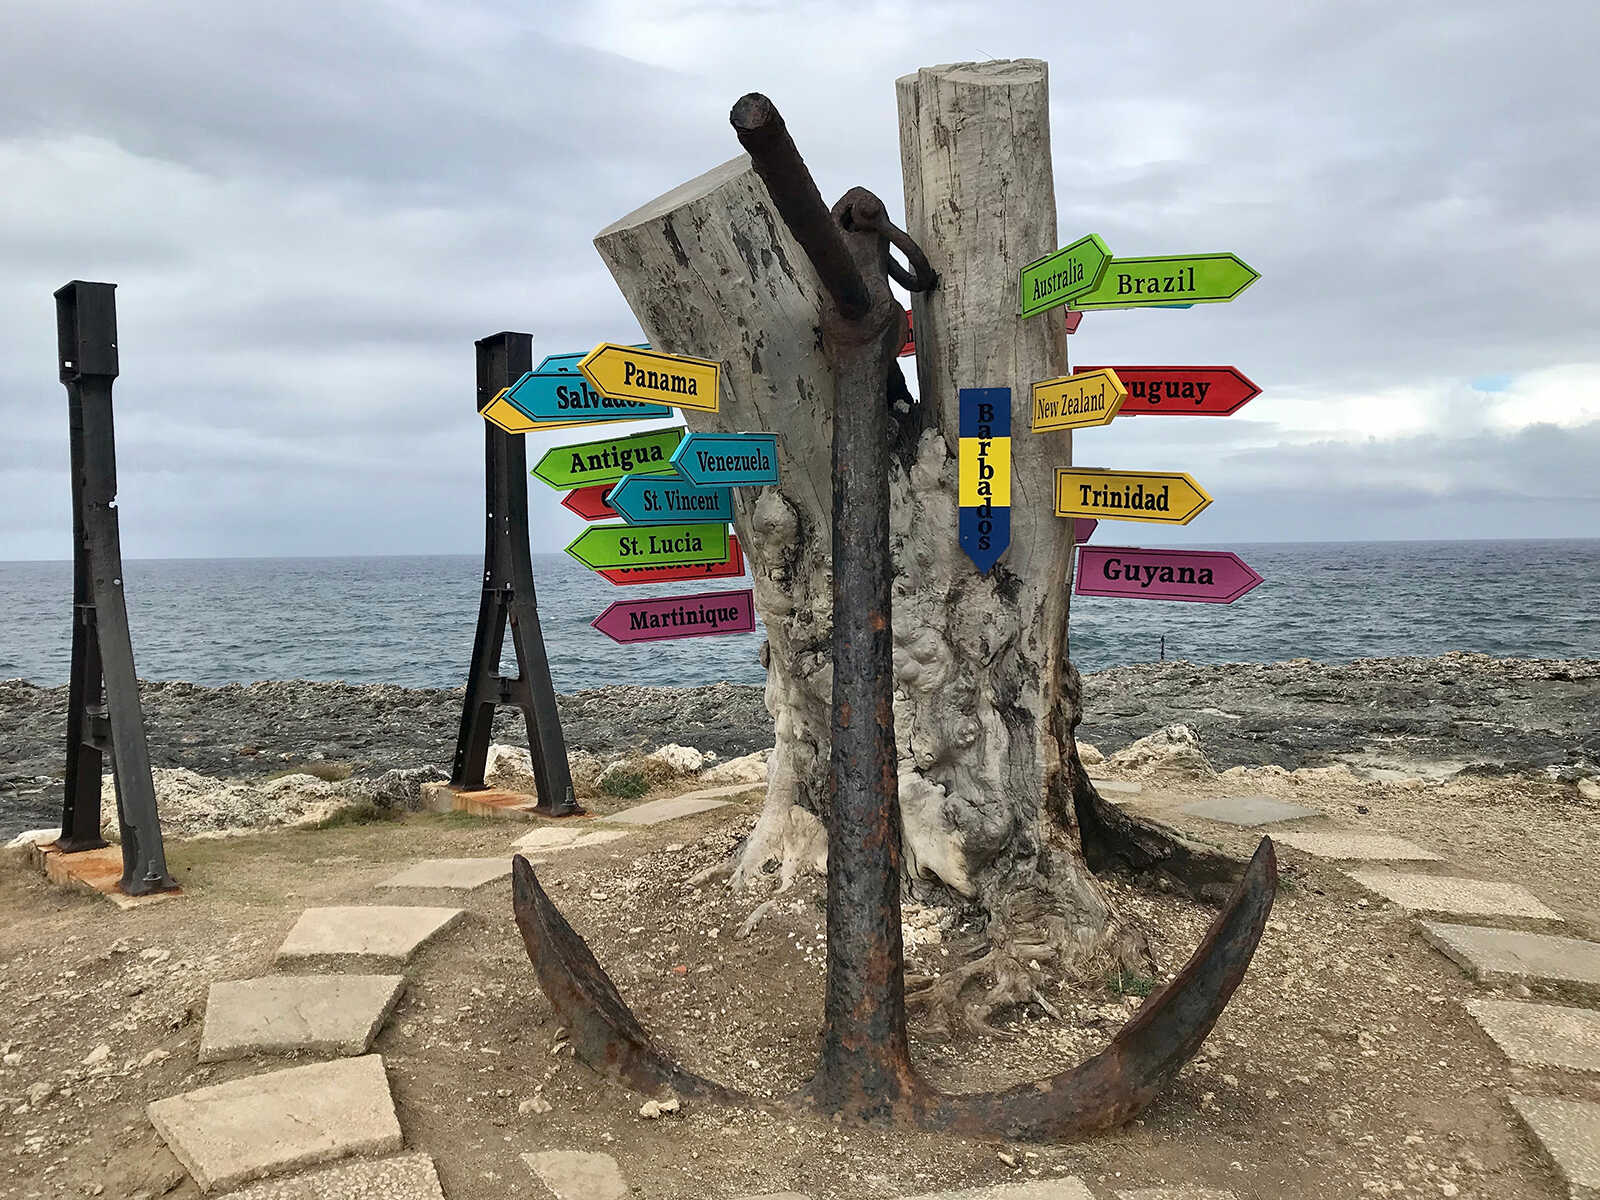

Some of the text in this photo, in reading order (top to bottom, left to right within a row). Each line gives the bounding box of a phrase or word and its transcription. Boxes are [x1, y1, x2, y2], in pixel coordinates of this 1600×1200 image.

[1032, 258, 1084, 300] Australia
[1116, 267, 1196, 295] Brazil
[624, 361, 698, 395] Panama
[1037, 384, 1105, 420] New Zealand
[570, 445, 664, 474] Antigua
[696, 448, 770, 472] Venezuela
[976, 403, 995, 551] Barbados
[643, 489, 720, 511] St. Vincent
[1079, 484, 1169, 512] Trinidad
[619, 532, 703, 556] St. Lucia
[1103, 557, 1214, 586] Guyana
[629, 604, 739, 630] Martinique
